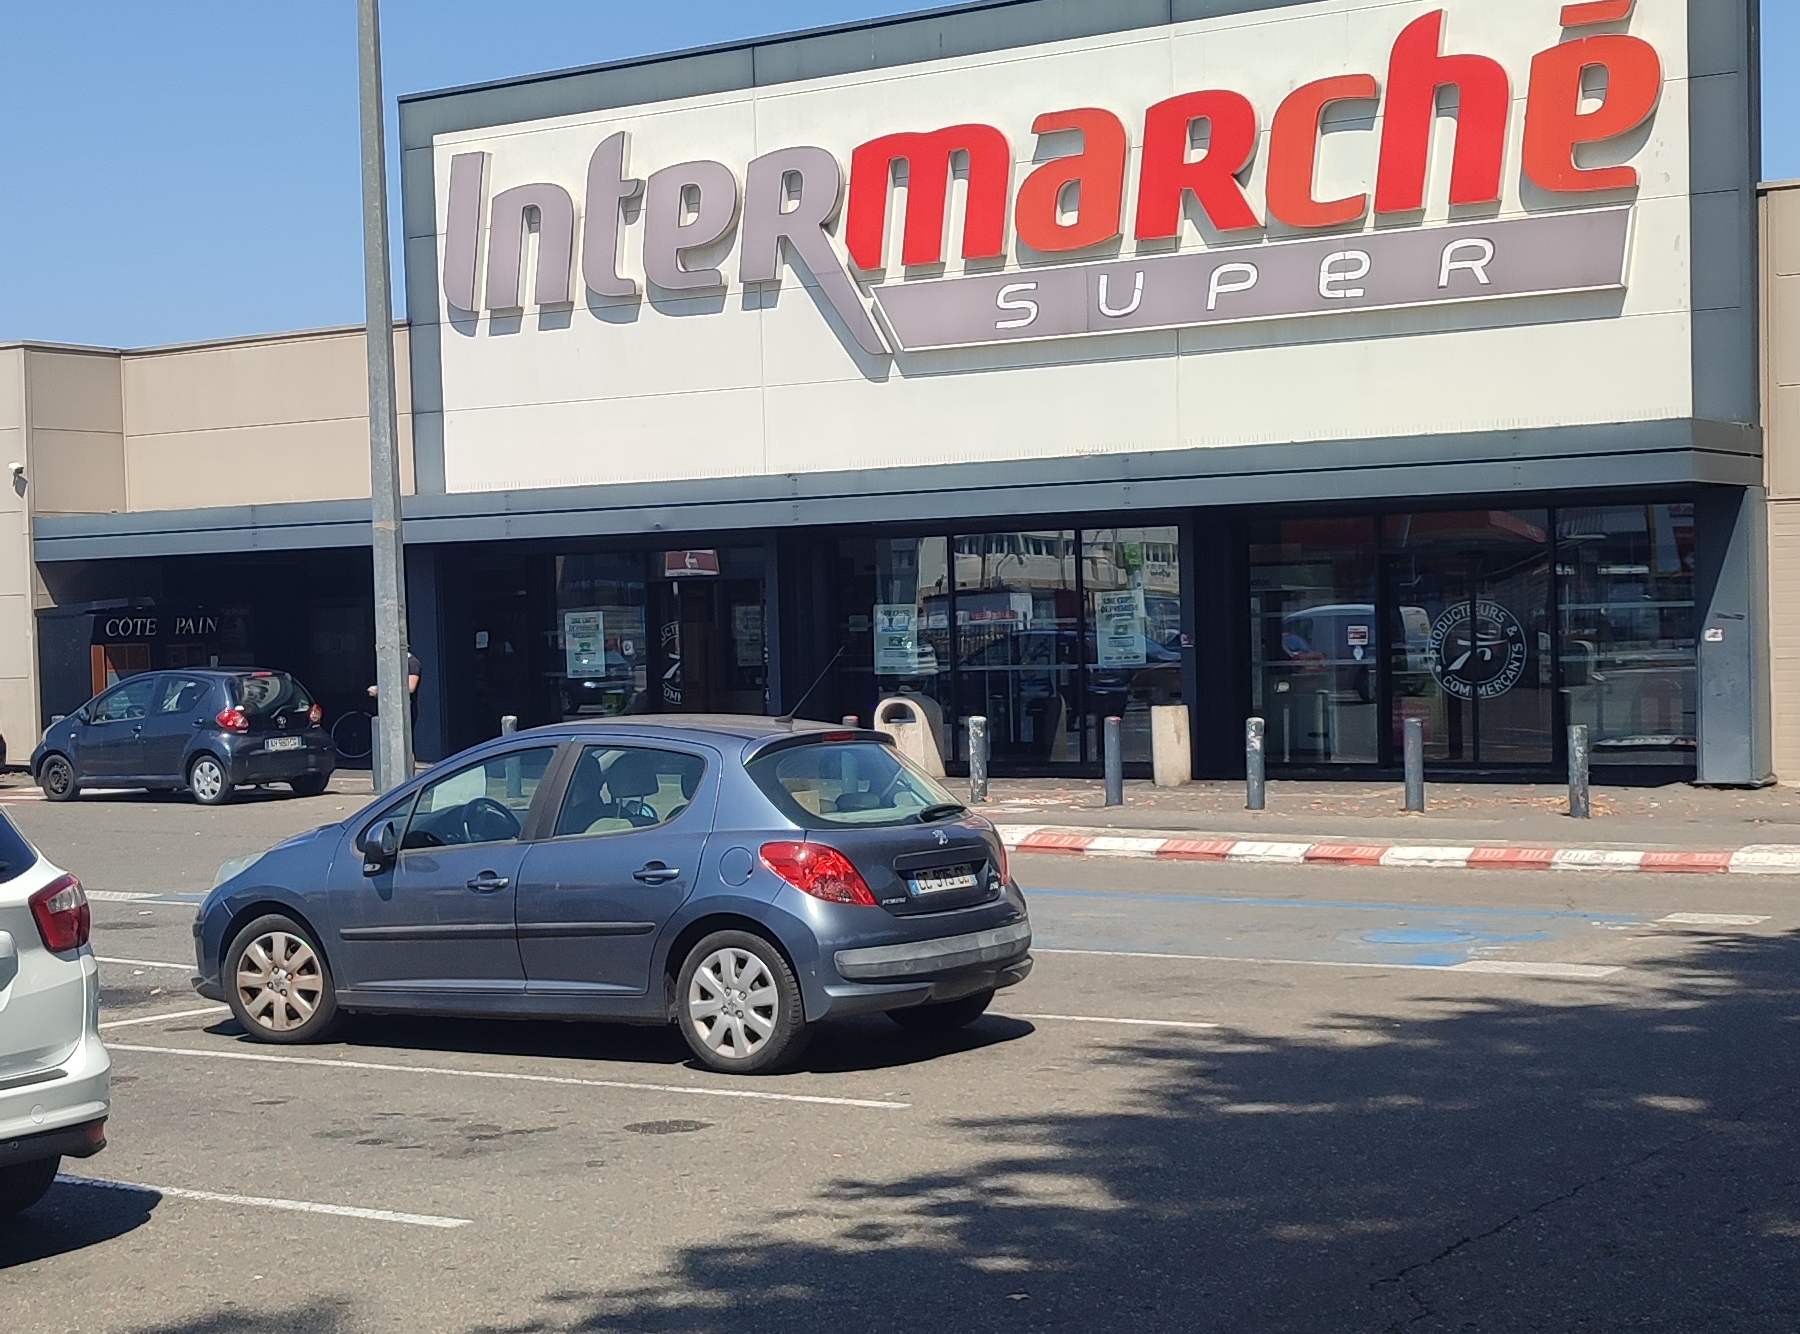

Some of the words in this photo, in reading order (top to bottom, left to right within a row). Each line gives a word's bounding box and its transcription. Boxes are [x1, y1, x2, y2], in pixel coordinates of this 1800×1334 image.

[175, 616, 219, 635] PAIN
[1429, 603, 1507, 658] PRODUCTEURS
[1506, 625, 1518, 638] &
[1442, 642, 1523, 696] COMMERÇANTS
